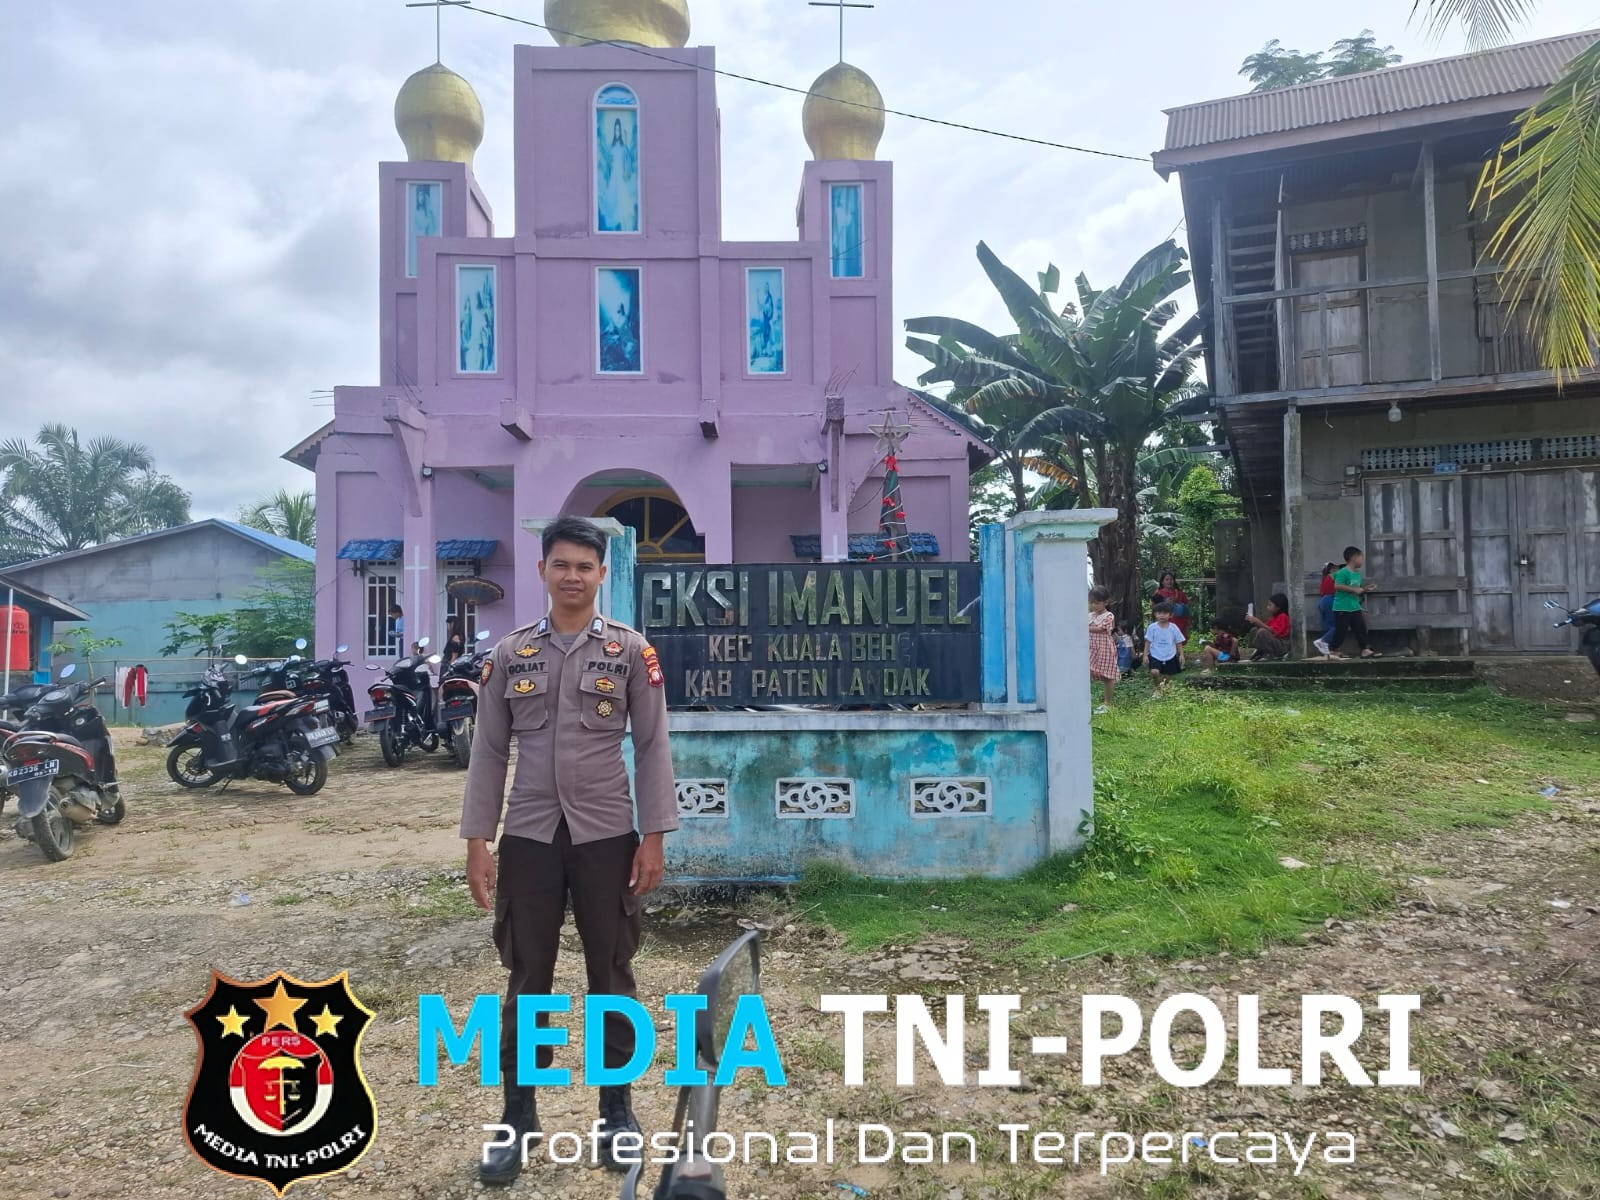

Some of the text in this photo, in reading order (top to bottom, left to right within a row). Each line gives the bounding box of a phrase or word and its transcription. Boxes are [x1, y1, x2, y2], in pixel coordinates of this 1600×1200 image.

[643, 569, 972, 628] GKSI IMANUEL
[709, 634, 753, 662] KEC
[768, 633, 843, 662] KUALA
[587, 660, 628, 676] POLRI
[685, 669, 733, 698] KAB
[751, 669, 828, 698] PATEN
